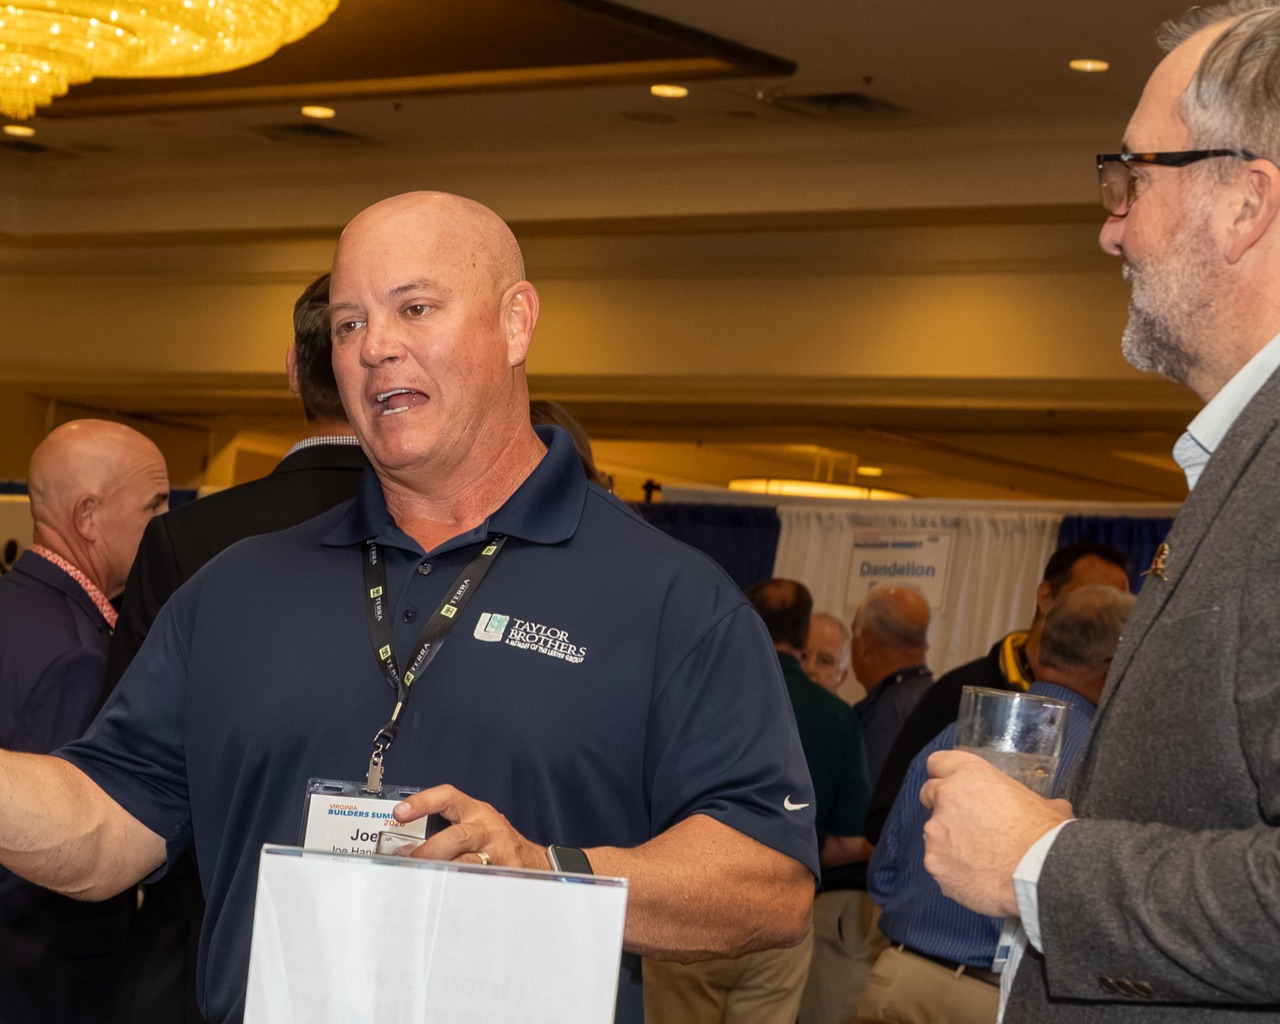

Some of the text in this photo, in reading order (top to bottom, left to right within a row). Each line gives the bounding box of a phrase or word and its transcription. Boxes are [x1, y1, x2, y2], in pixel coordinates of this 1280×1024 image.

[859, 560, 936, 578] Dandelion
[449, 579, 470, 605] TERRA
[375, 597, 383, 621] TERRA
[513, 618, 570, 643] TAYLOR
[508, 629, 587, 657] BROTHERS
[411, 643, 430, 672] TERRA
[387, 658, 400, 682] TERR
[328, 809, 370, 818] BUILDERS
[329, 803, 358, 811] VIRGINIA
